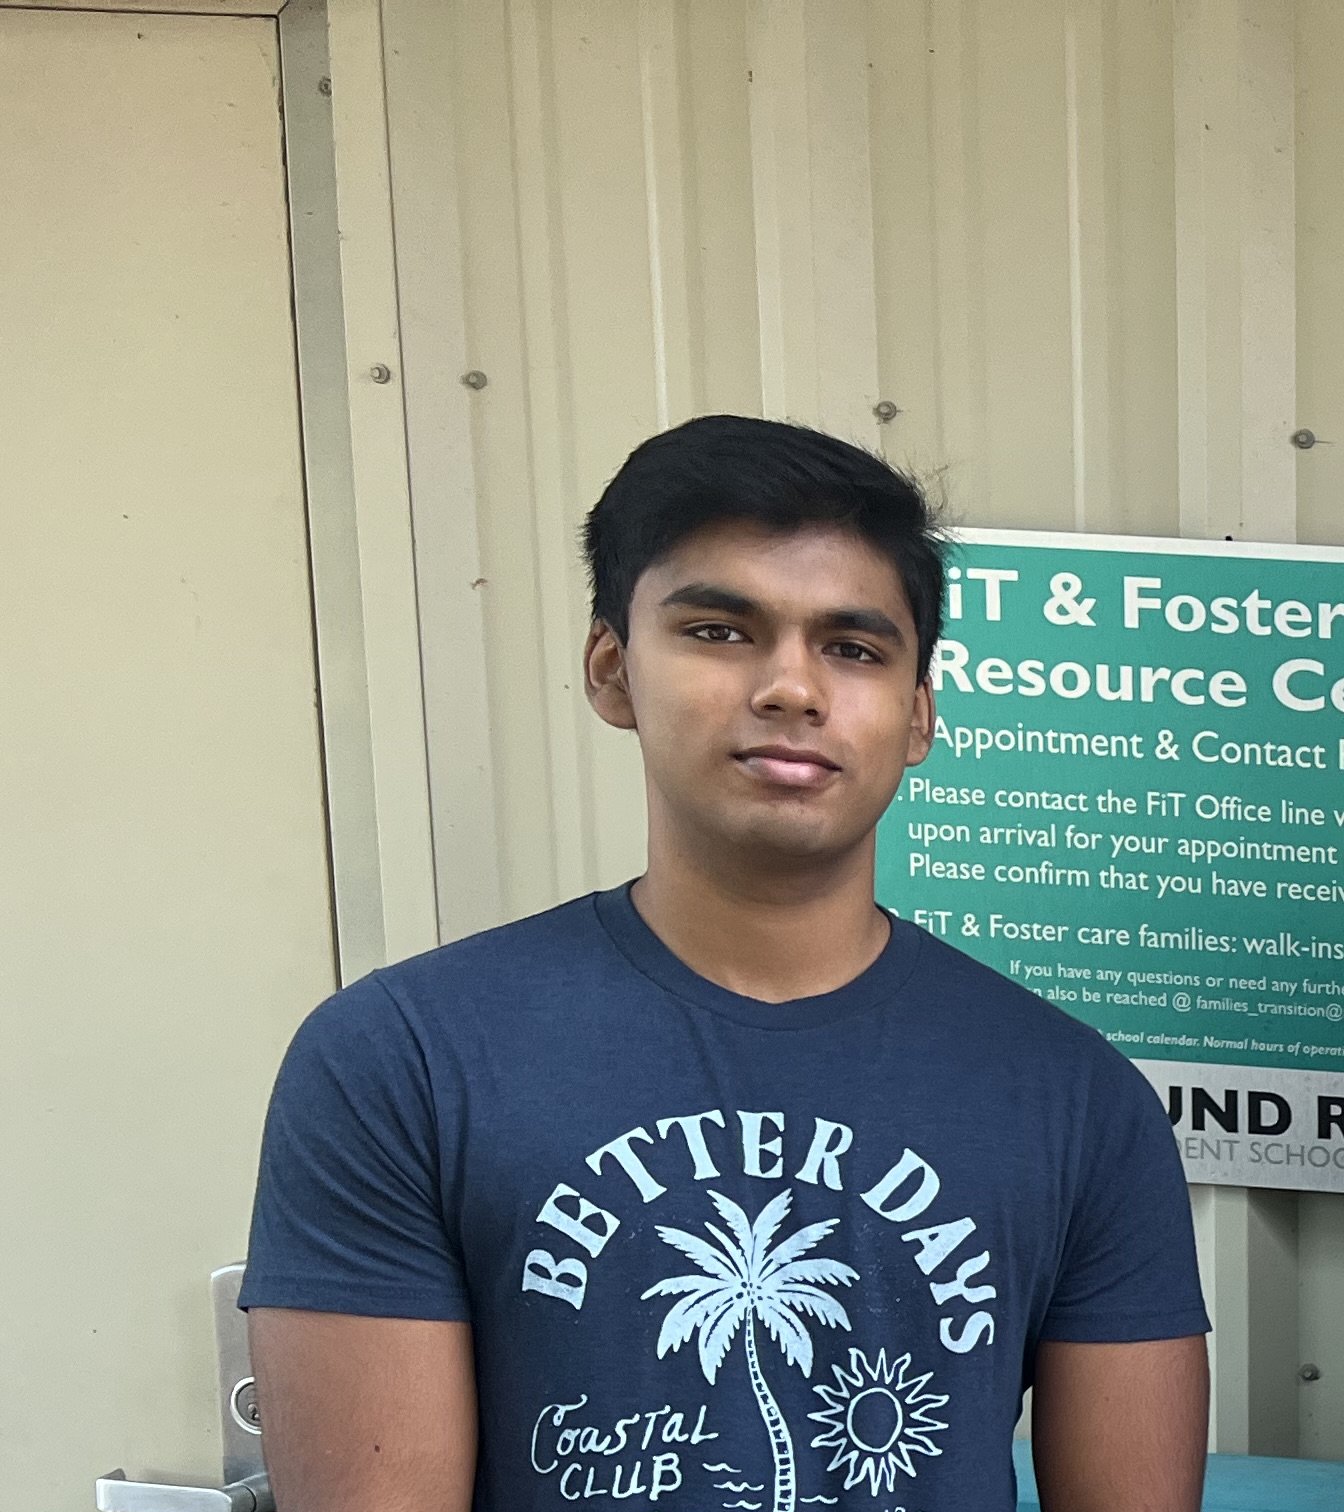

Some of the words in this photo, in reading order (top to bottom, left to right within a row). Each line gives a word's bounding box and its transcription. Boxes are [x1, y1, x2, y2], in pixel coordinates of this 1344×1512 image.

[947, 566, 1019, 621] iT
[1043, 572, 1097, 627] &
[932, 639, 1247, 708] Resource
[933, 719, 1145, 760] Appointment
[1154, 729, 1180, 761] &
[1191, 730, 1327, 769] Contact
[909, 777, 986, 806] Please
[994, 789, 1089, 812] contact
[1096, 788, 1137, 815] the
[1147, 791, 1187, 817] FiT
[1195, 794, 1272, 823] Office
[1281, 799, 1325, 826] line
[908, 822, 971, 848] upon
[979, 823, 1056, 848] arrival
[1064, 824, 1103, 850] for
[1110, 834, 1170, 859] your
[1177, 836, 1338, 865] appointment
[909, 852, 986, 881] Please
[993, 860, 1090, 887] confirm
[1098, 864, 1150, 891] that
[1156, 874, 1202, 899] you
[1211, 870, 1267, 898] have
[913, 909, 953, 935] FiT
[961, 913, 980, 937] &
[989, 914, 1070, 942] Foster
[1077, 927, 1130, 946] care
[1138, 923, 1237, 953] families:
[1242, 932, 1344, 960] walk-ins
[1009, 959, 1022, 975] If
[1023, 965, 1053, 981] you
[1057, 962, 1092, 980] have
[1095, 969, 1123, 986] any
[1126, 970, 1201, 987] questions
[1205, 976, 1225, 988] or
[1228, 976, 1267, 991] need
[1271, 980, 1298, 997] any
[1046, 985, 1078, 1002] also
[1082, 986, 1102, 1003] be
[1106, 990, 1168, 1007] reached
[1172, 991, 1192, 1013] @
[1106, 1031, 1144, 1044] school
[1147, 1032, 1200, 1047] calendar.
[1202, 1036, 1249, 1050] Normal
[1251, 1039, 1284, 1052] hours
[1287, 1042, 1302, 1056] of
[521, 1110, 853, 1310] BETTER
[860, 1147, 997, 1353] DAYS
[560, 1455, 683, 1501] CLUB
